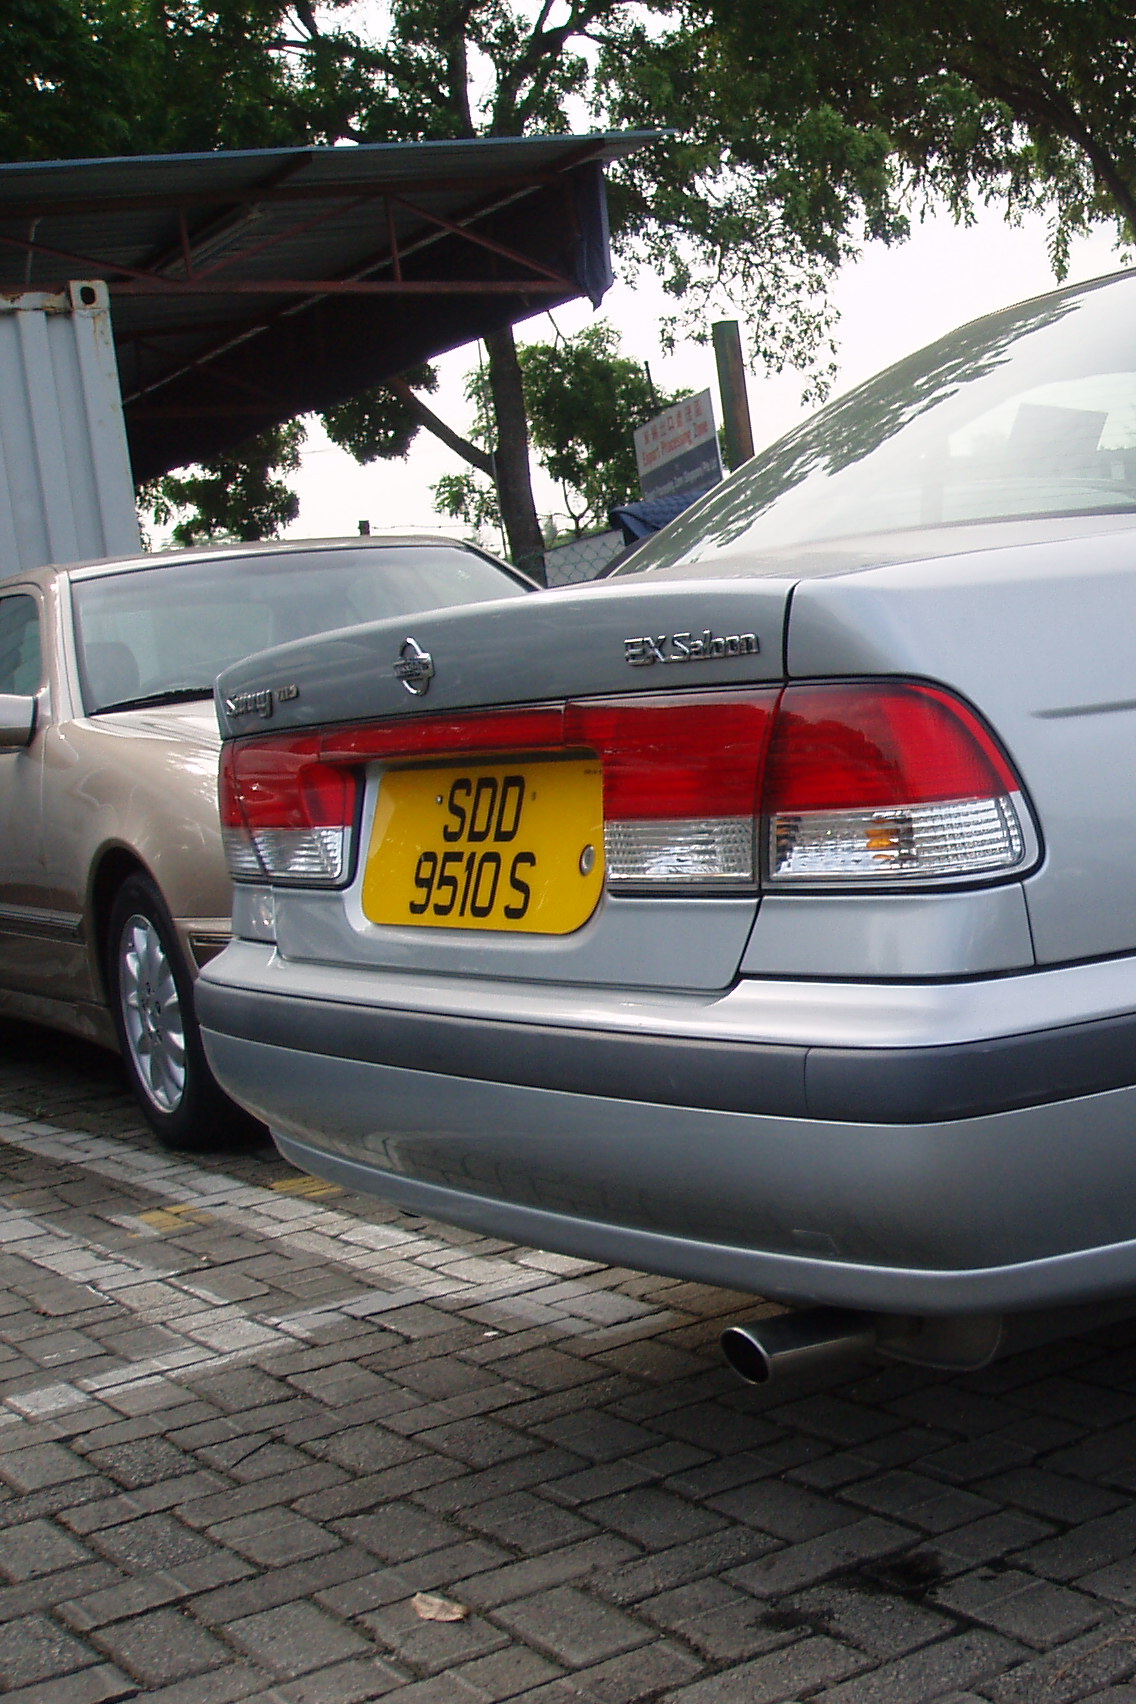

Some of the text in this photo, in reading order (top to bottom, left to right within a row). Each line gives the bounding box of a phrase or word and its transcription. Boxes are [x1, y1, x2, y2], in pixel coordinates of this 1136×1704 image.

[624, 629, 760, 666] EX Saloon
[226, 688, 273, 718] Sunny
[443, 775, 525, 842] SDD
[409, 852, 502, 918] 9510
